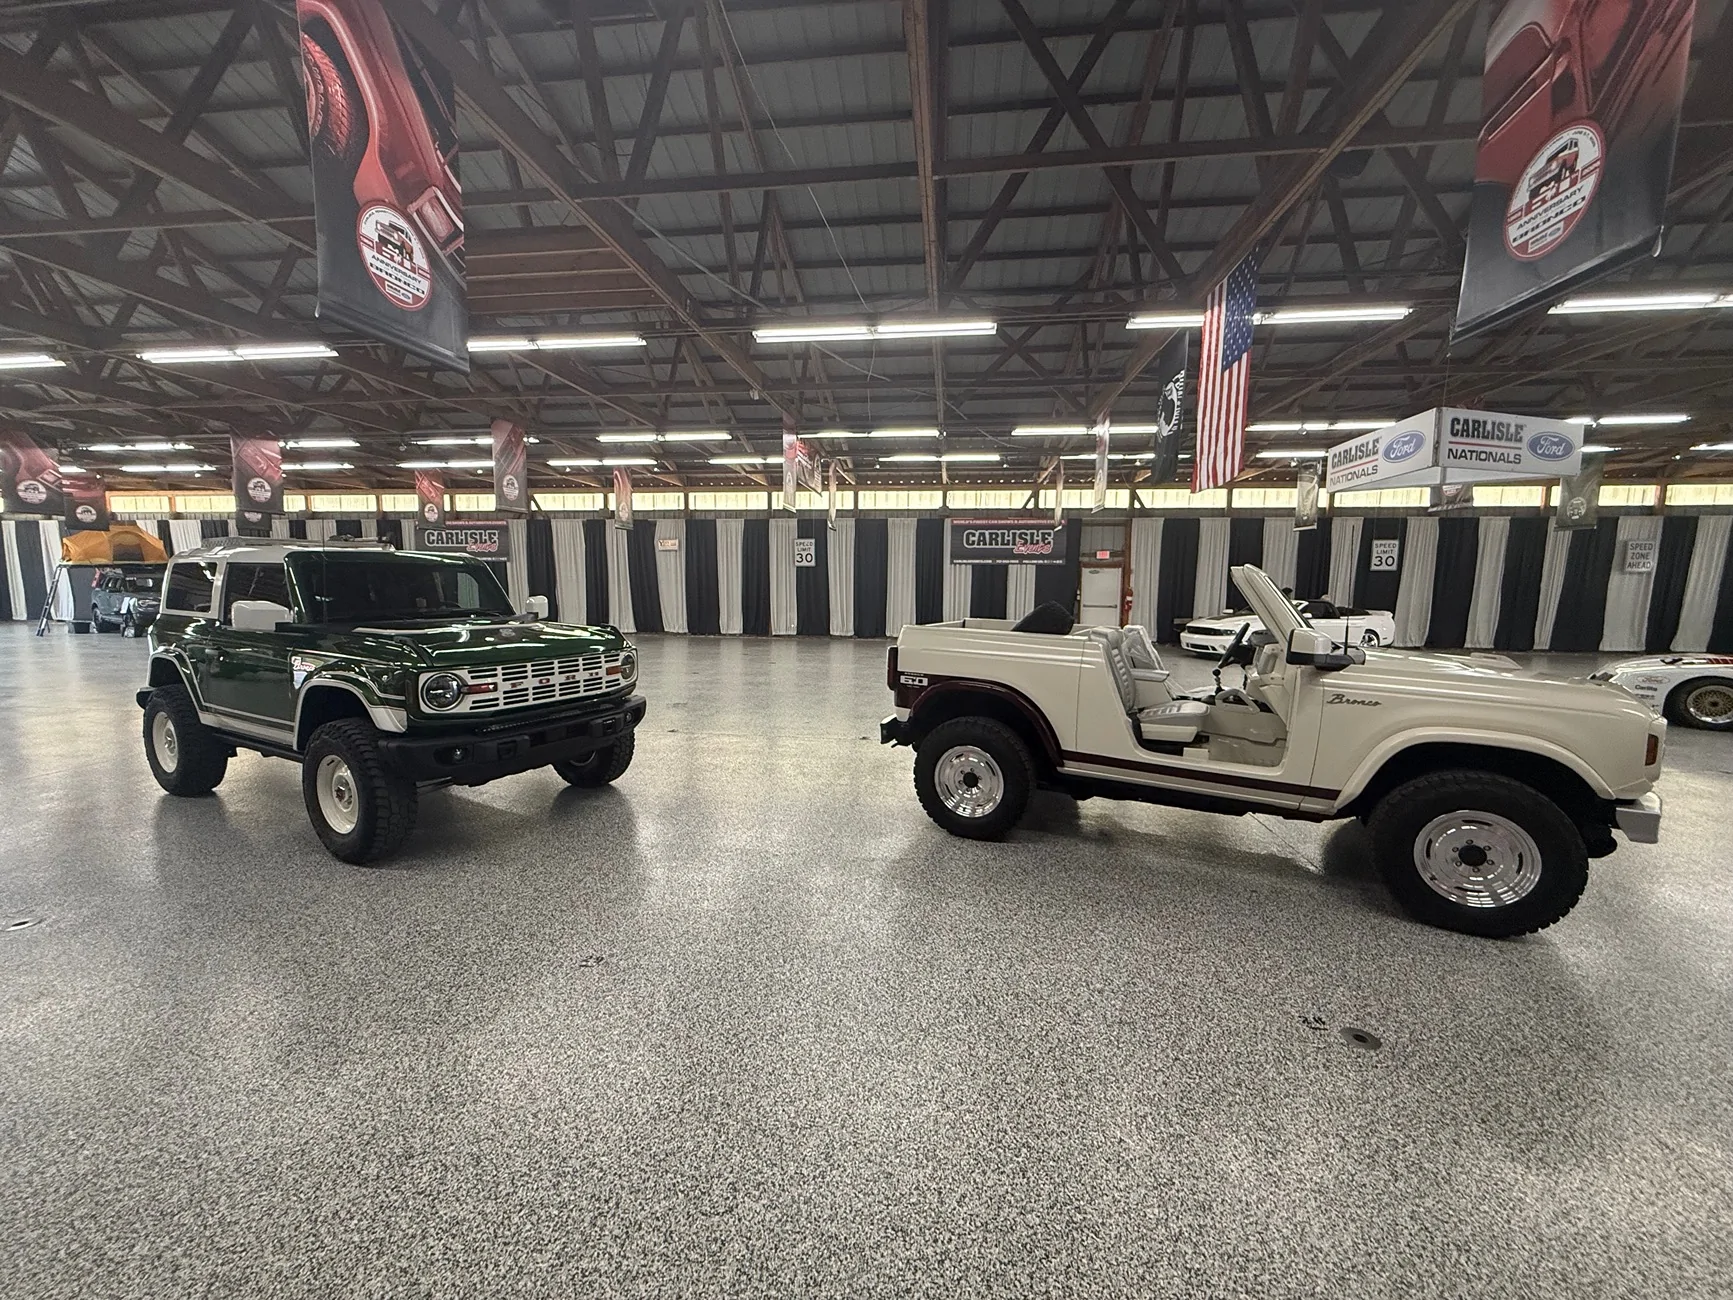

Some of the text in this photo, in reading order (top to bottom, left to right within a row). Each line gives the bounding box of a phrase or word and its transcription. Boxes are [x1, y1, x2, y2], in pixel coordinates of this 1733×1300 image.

[1517, 185, 1584, 231] ANNIVERSARY
[371, 254, 422, 285] ANNIVERSARY
[1450, 417, 1524, 443] CARLISLE
[1331, 439, 1380, 470] CARLISLE
[1390, 435, 1416, 458] Ford
[1537, 436, 1564, 456] Ford
[1447, 448, 1522, 465] NATIONALS
[1329, 465, 1379, 487] NATIONALS
[426, 531, 498, 547] CARLISLE
[964, 530, 1053, 548] CARLISLE
[1629, 543, 1653, 551] SPEED
[796, 553, 813, 564] 30
[1374, 555, 1395, 567] 30
[1631, 552, 1651, 560] ZONE
[1627, 561, 1651, 569] AHEAD
[1327, 693, 1382, 707] Bronco
